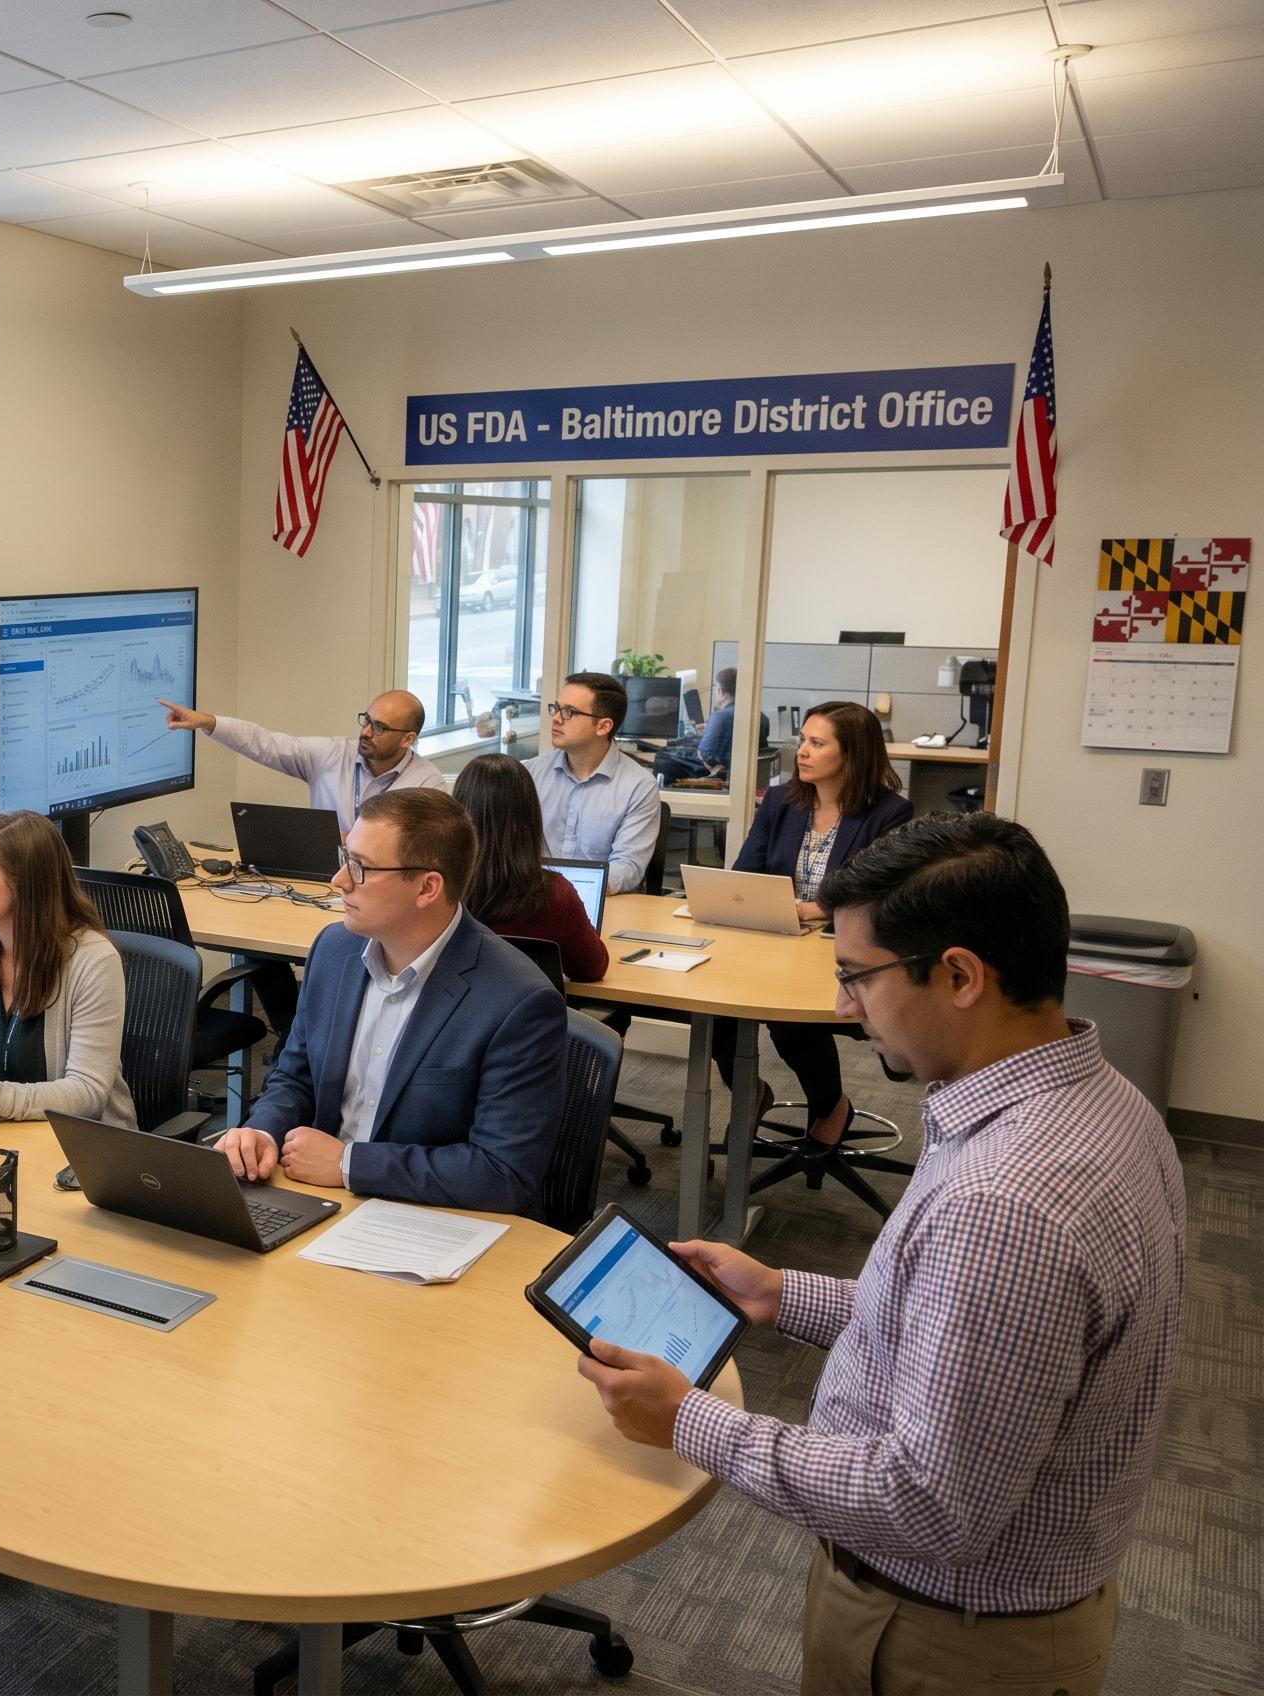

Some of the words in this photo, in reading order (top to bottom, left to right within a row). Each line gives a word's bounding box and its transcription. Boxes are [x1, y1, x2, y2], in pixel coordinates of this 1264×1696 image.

[418, 412, 458, 446] US
[466, 409, 528, 444] FDA
[537, 423, 551, 432] -
[560, 404, 723, 441] Baltimore
[733, 395, 867, 434] District
[878, 389, 994, 429] Office
